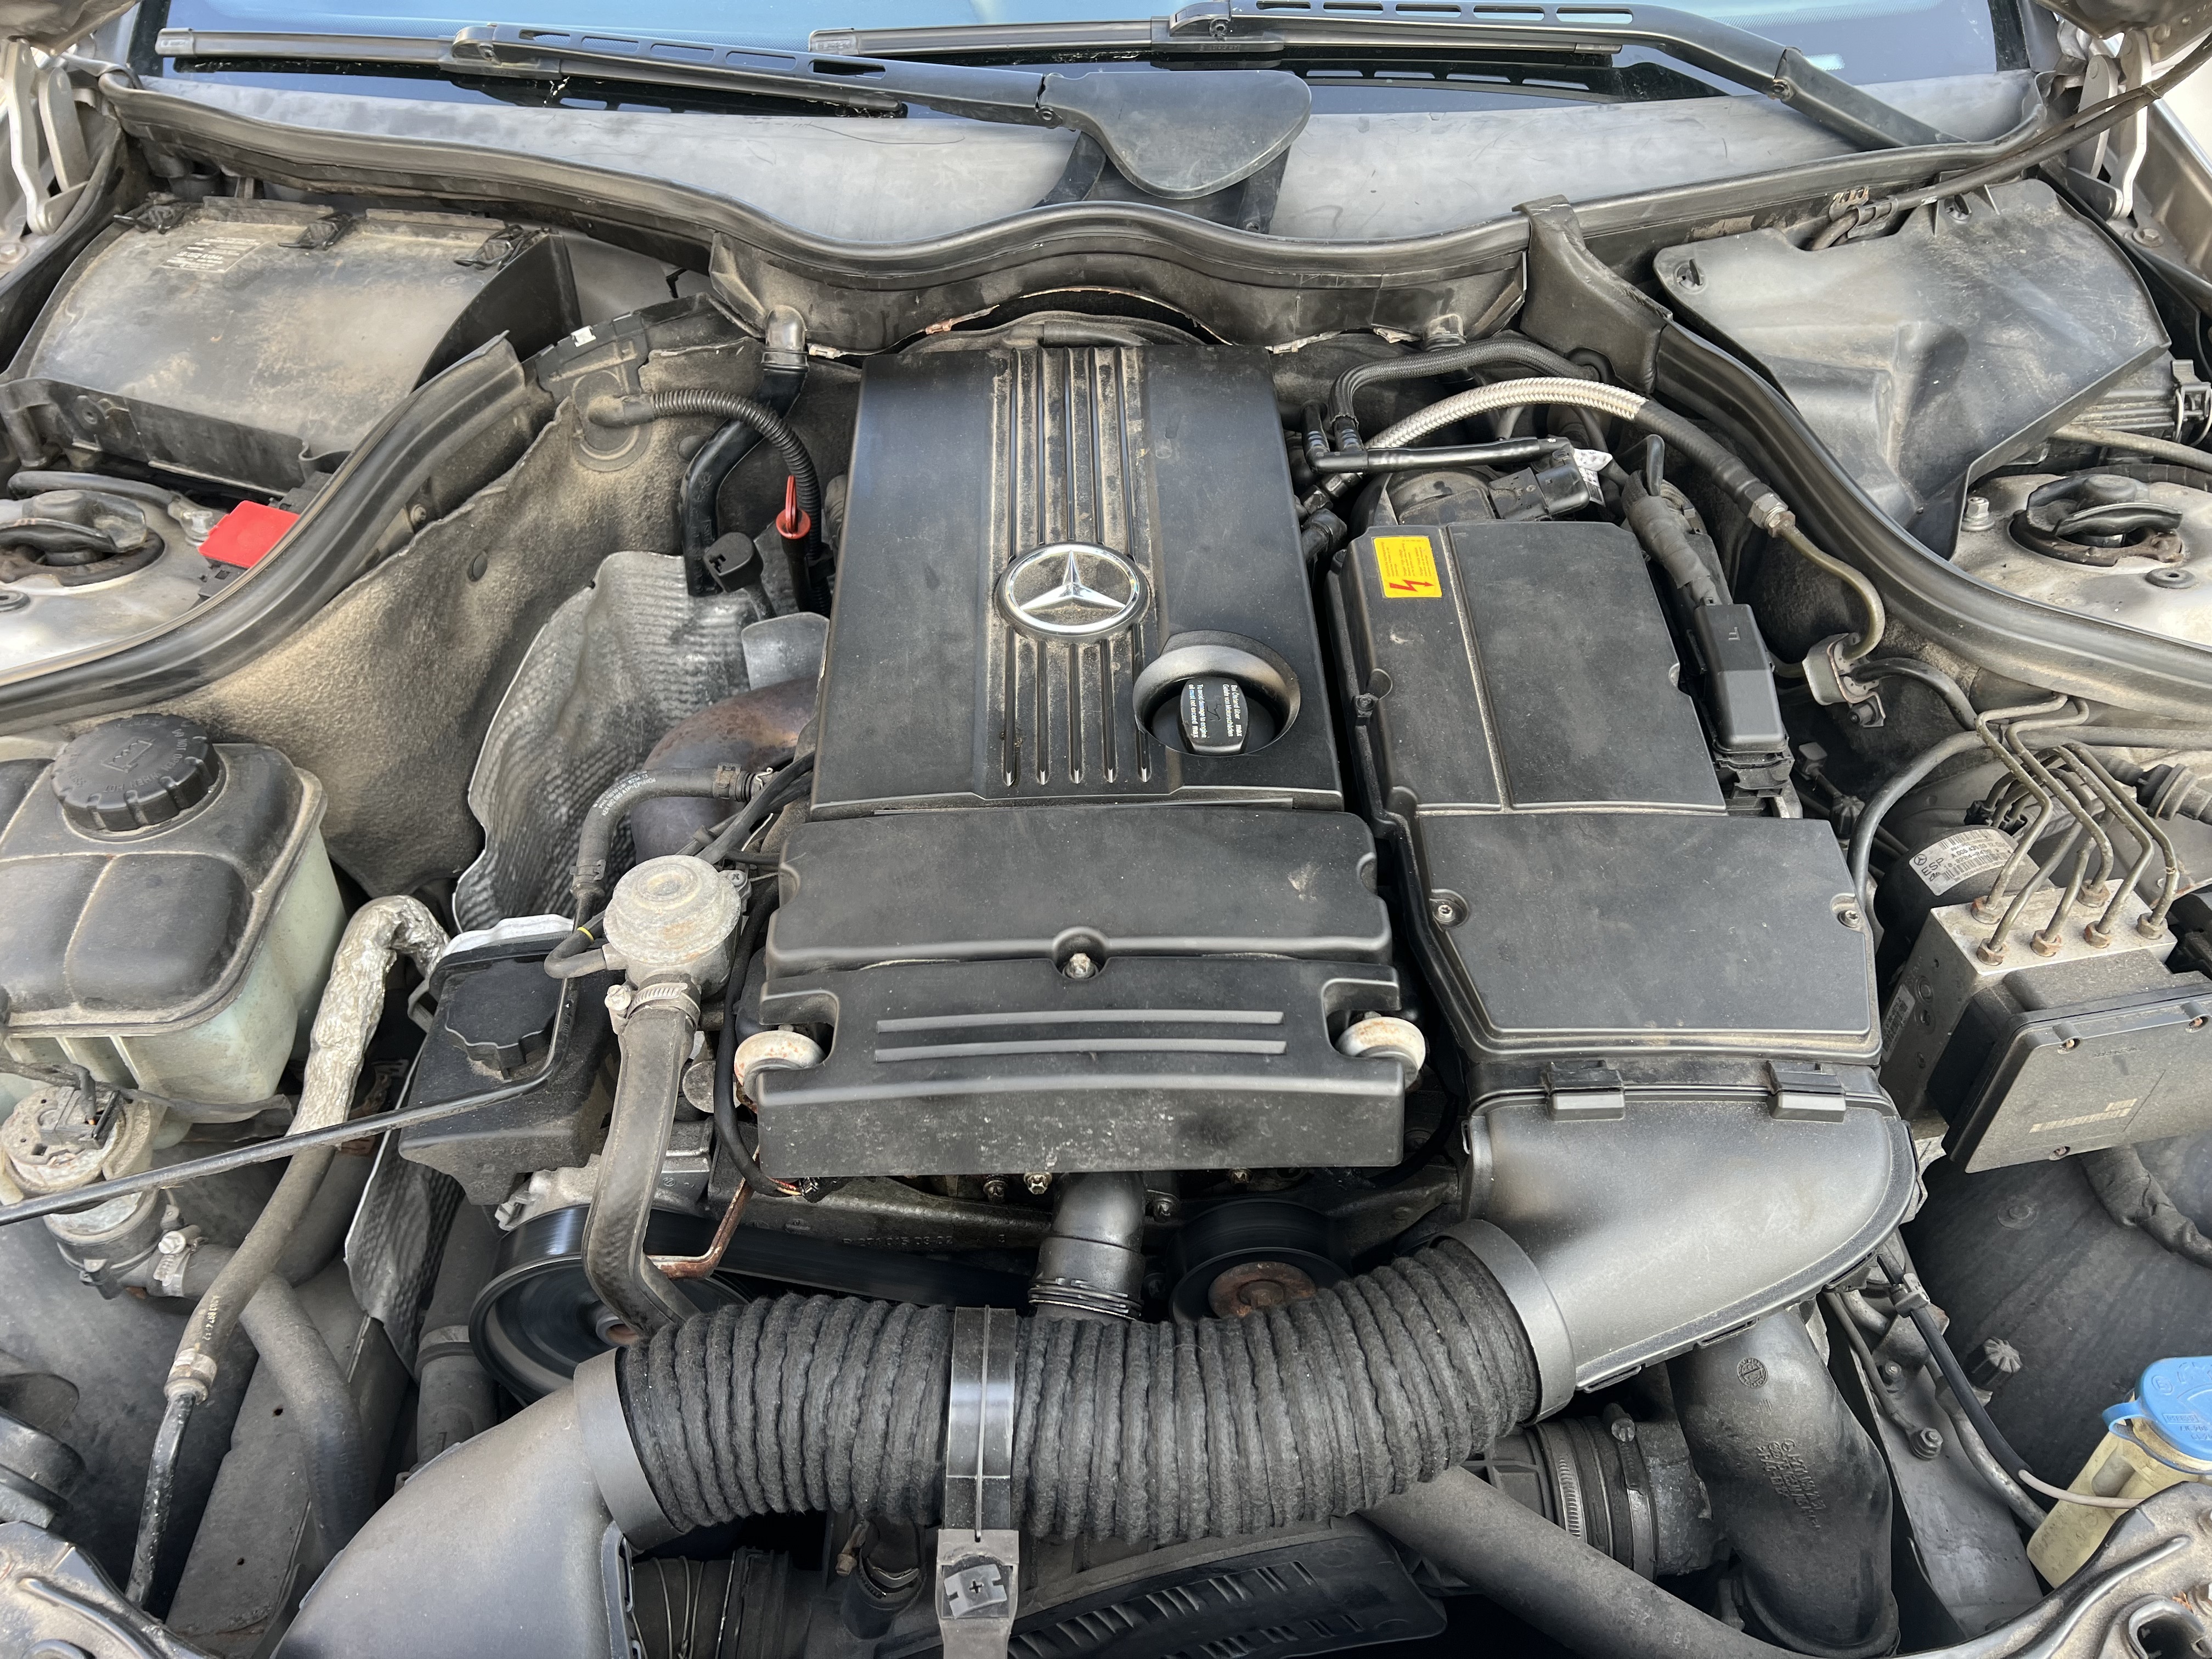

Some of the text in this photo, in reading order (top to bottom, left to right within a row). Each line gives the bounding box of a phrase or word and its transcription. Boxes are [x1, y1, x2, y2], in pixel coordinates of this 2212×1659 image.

[1190, 707, 1199, 724] exceed
[1199, 722, 1207, 738] engine
[176, 738, 188, 751] NOT
[162, 753, 183, 771] OPEN
[104, 783, 125, 793] HOT
[131, 773, 162, 787] WHEN
[1921, 857, 1944, 876] ESP
